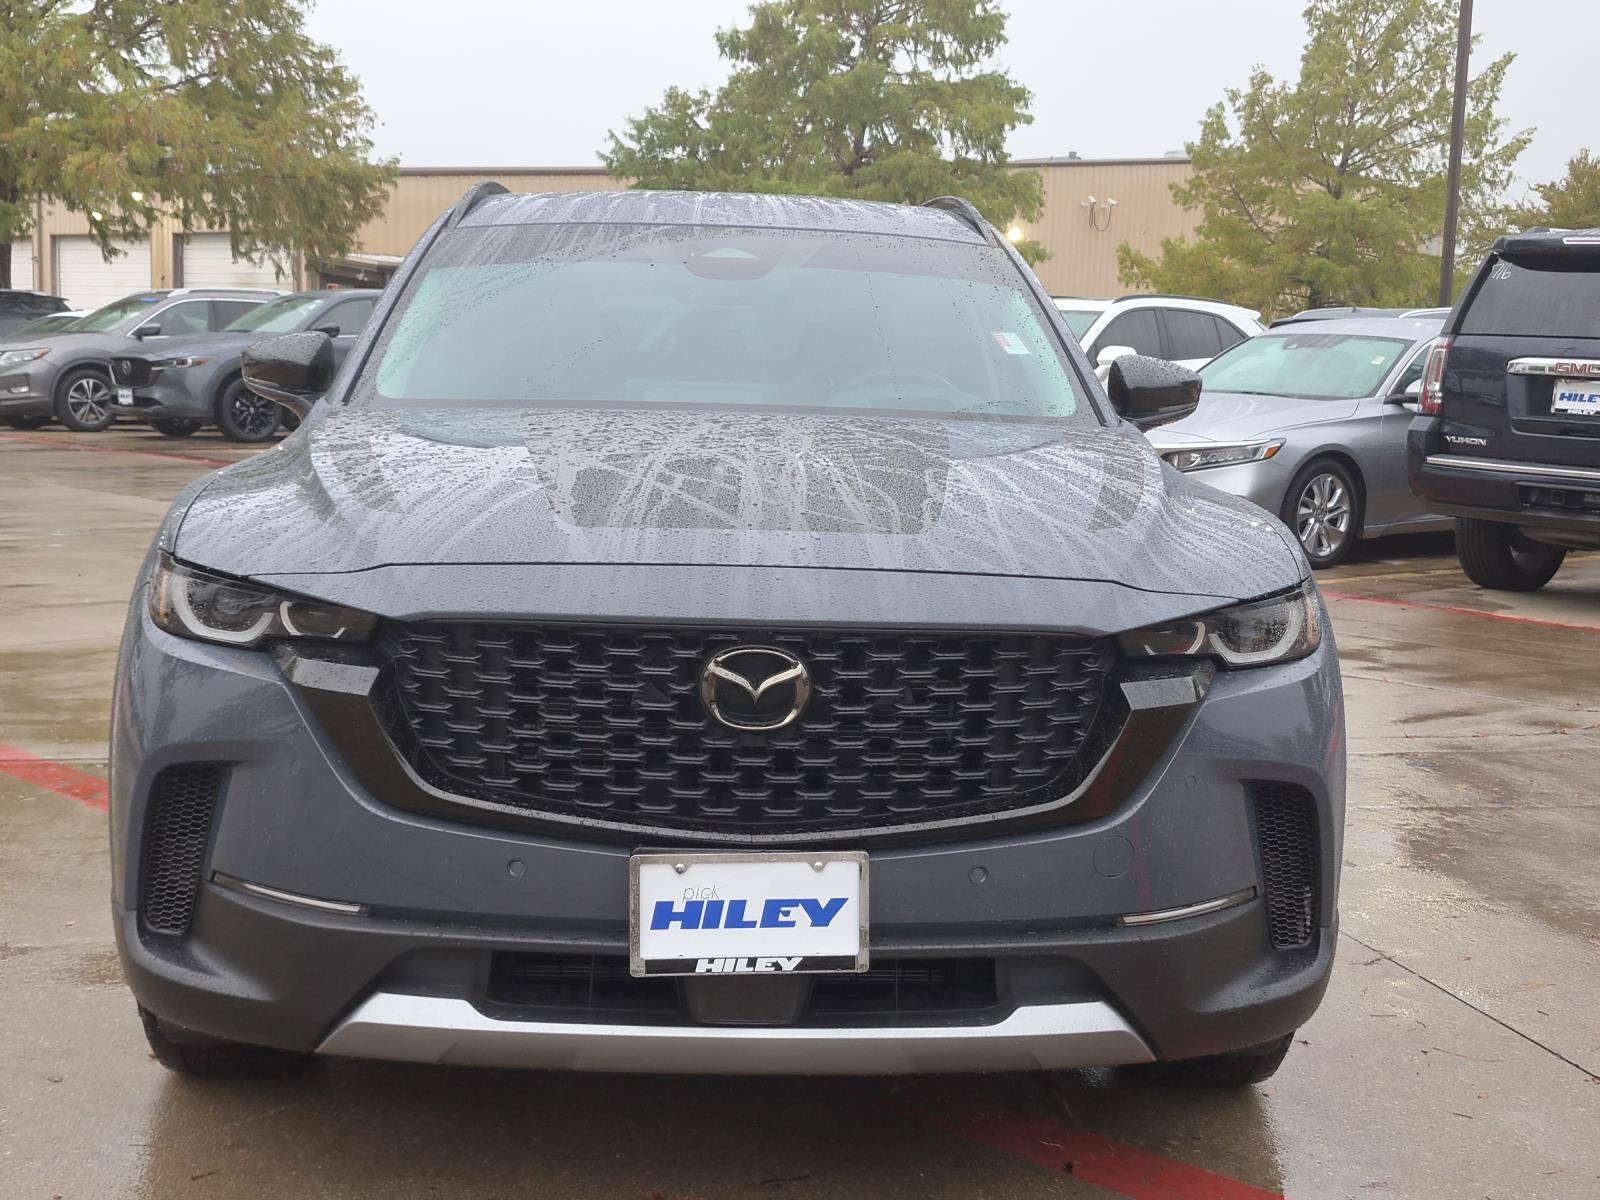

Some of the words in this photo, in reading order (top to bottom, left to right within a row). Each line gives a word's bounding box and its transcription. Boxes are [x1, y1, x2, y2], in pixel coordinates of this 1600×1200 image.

[1555, 362, 1600, 375] GMC
[1559, 392, 1600, 403] HILE
[1445, 435, 1487, 446] YUKON
[682, 884, 720, 903] pick
[650, 898, 849, 930] HILEY
[695, 957, 803, 973] HILEY
